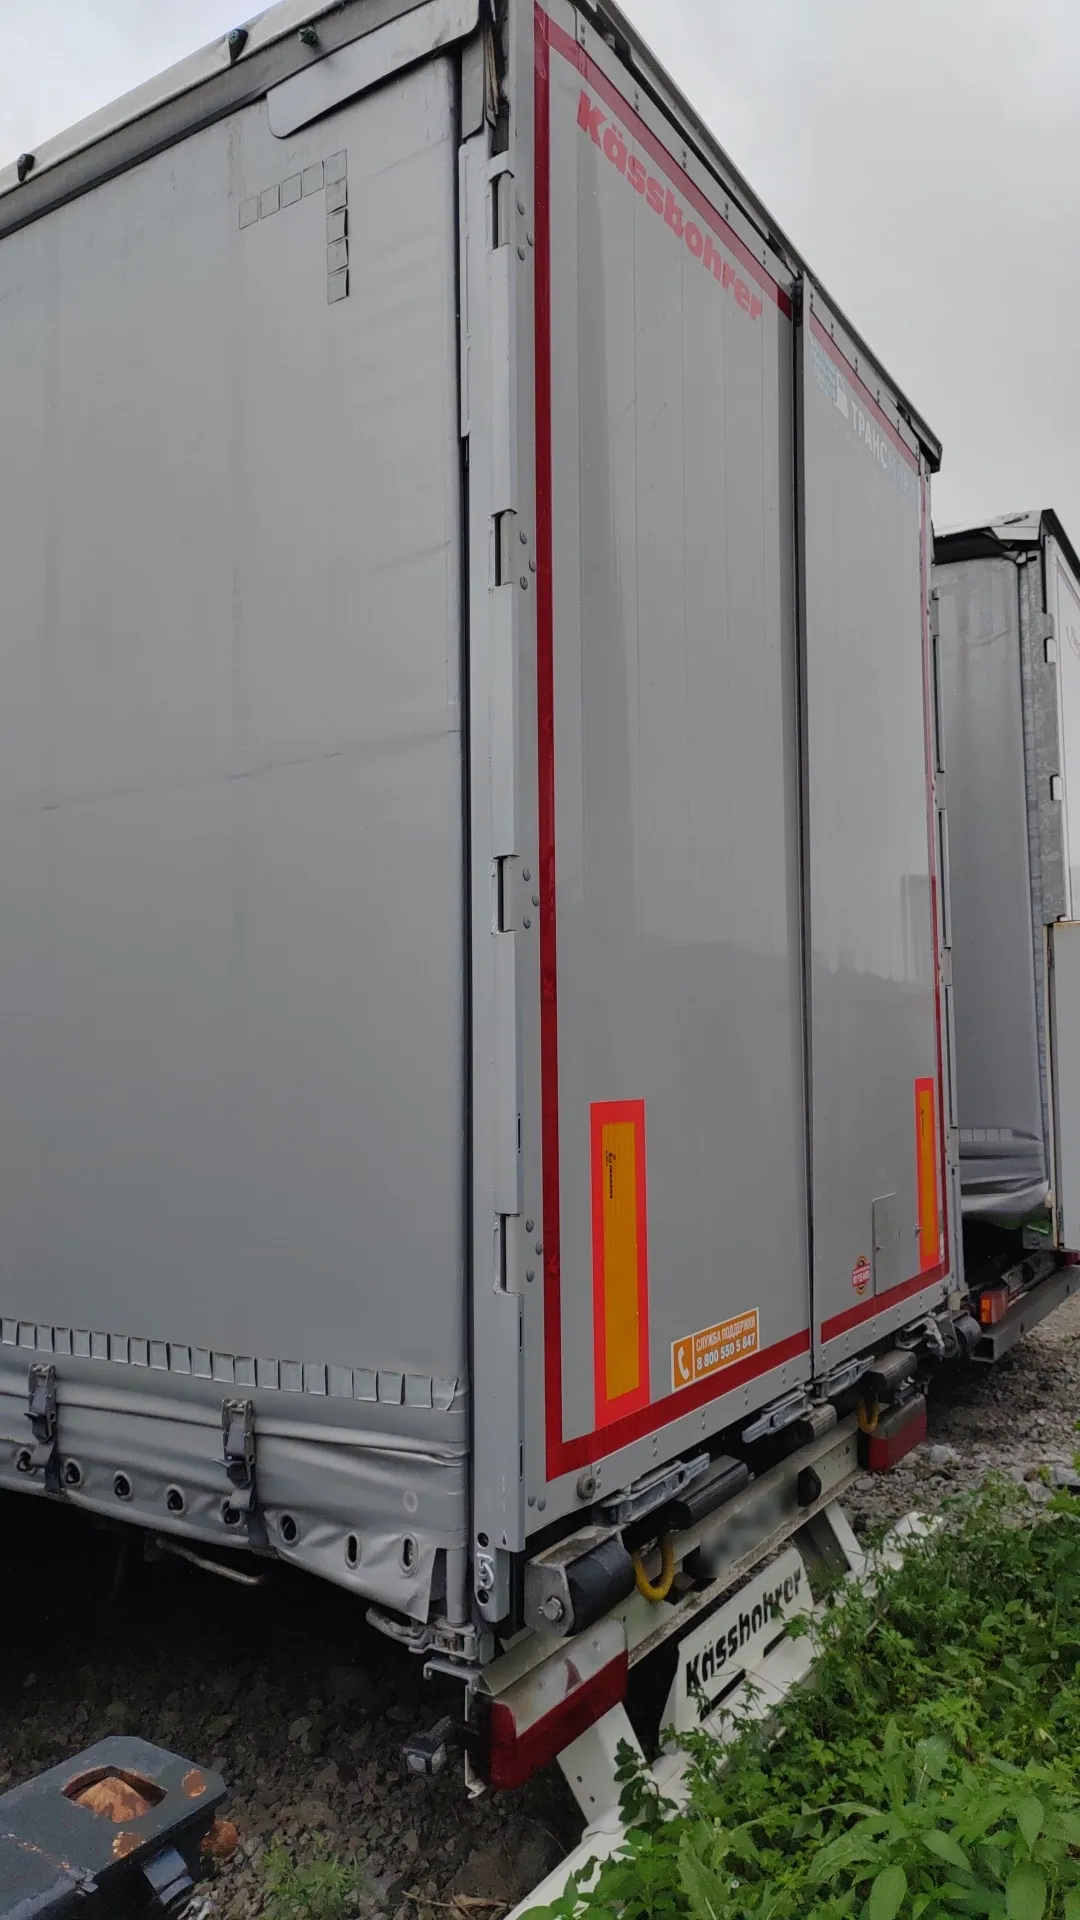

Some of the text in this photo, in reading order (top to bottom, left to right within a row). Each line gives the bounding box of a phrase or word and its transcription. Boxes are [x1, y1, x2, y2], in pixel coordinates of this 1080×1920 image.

[576, 89, 763, 321] Kässbohrer
[696, 1330, 721, 1352] СЛУЖБА
[697, 1332, 756, 1371] 8 800 550 5 847
